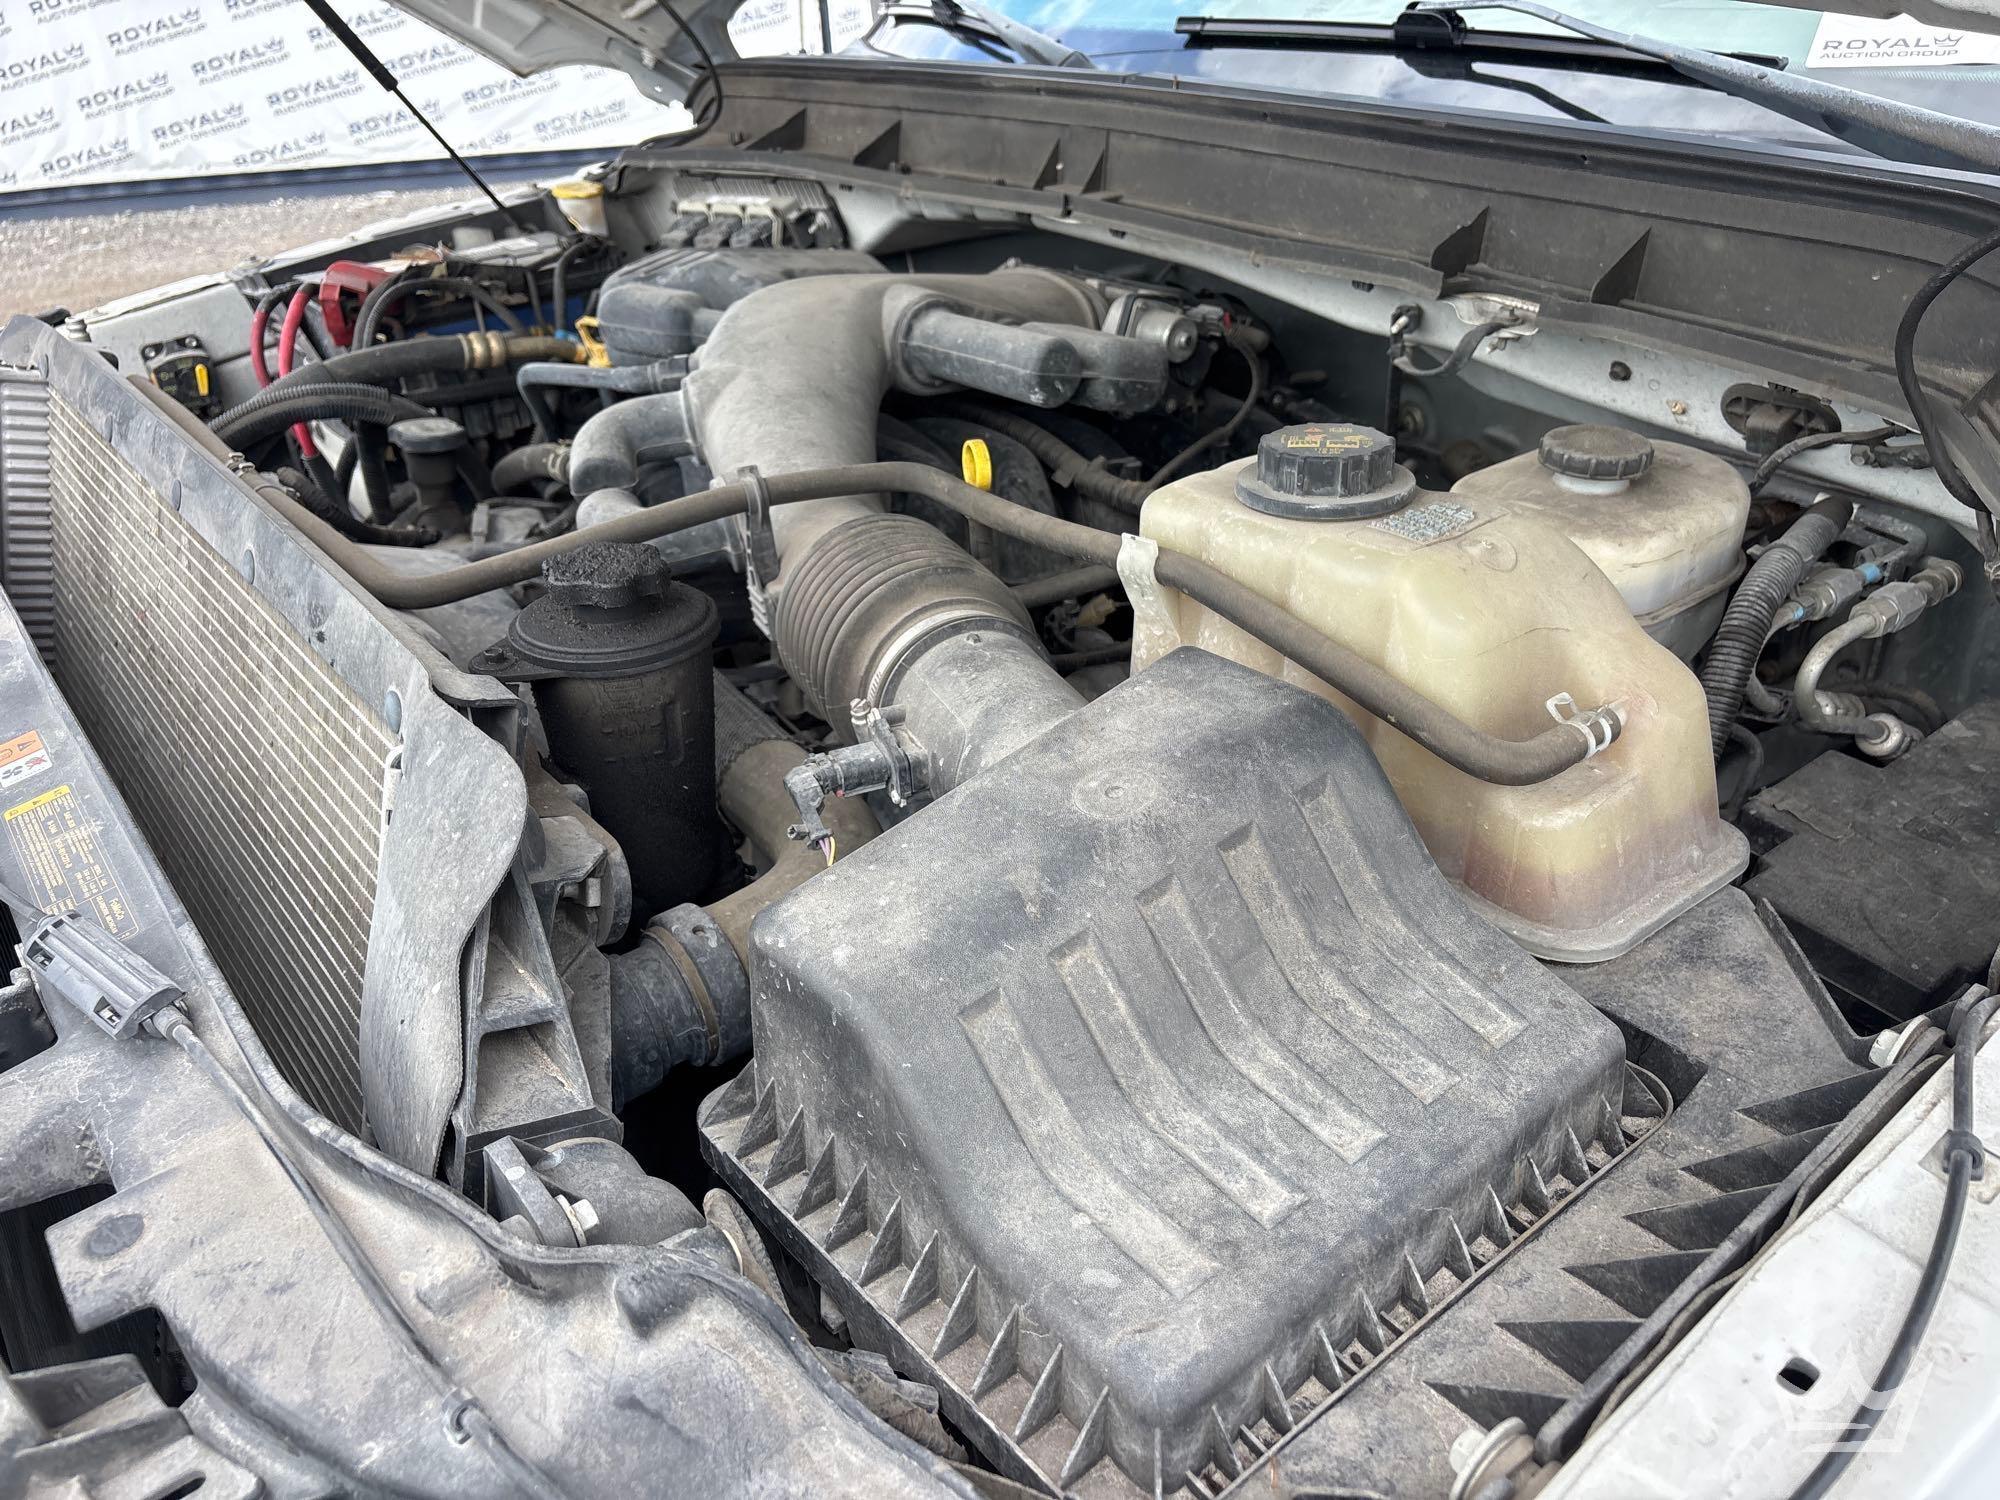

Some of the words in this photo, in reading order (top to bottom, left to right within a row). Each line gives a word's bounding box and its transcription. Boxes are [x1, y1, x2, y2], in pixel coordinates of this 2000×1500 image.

[107, 14, 183, 47] ROYAL
[1822, 37, 1930, 50] ROYAL
[191, 44, 266, 76] ROYAL
[382, 43, 456, 71] ROYAL
[1820, 51, 1894, 59] AUCTION
[77, 79, 151, 111] ROYAL
[266, 75, 340, 108] ROYAL
[152, 110, 226, 140] ROYAL
[534, 105, 608, 134] ROYAL
[40, 144, 112, 176] ROYAL
[232, 138, 306, 167] ROYAL
